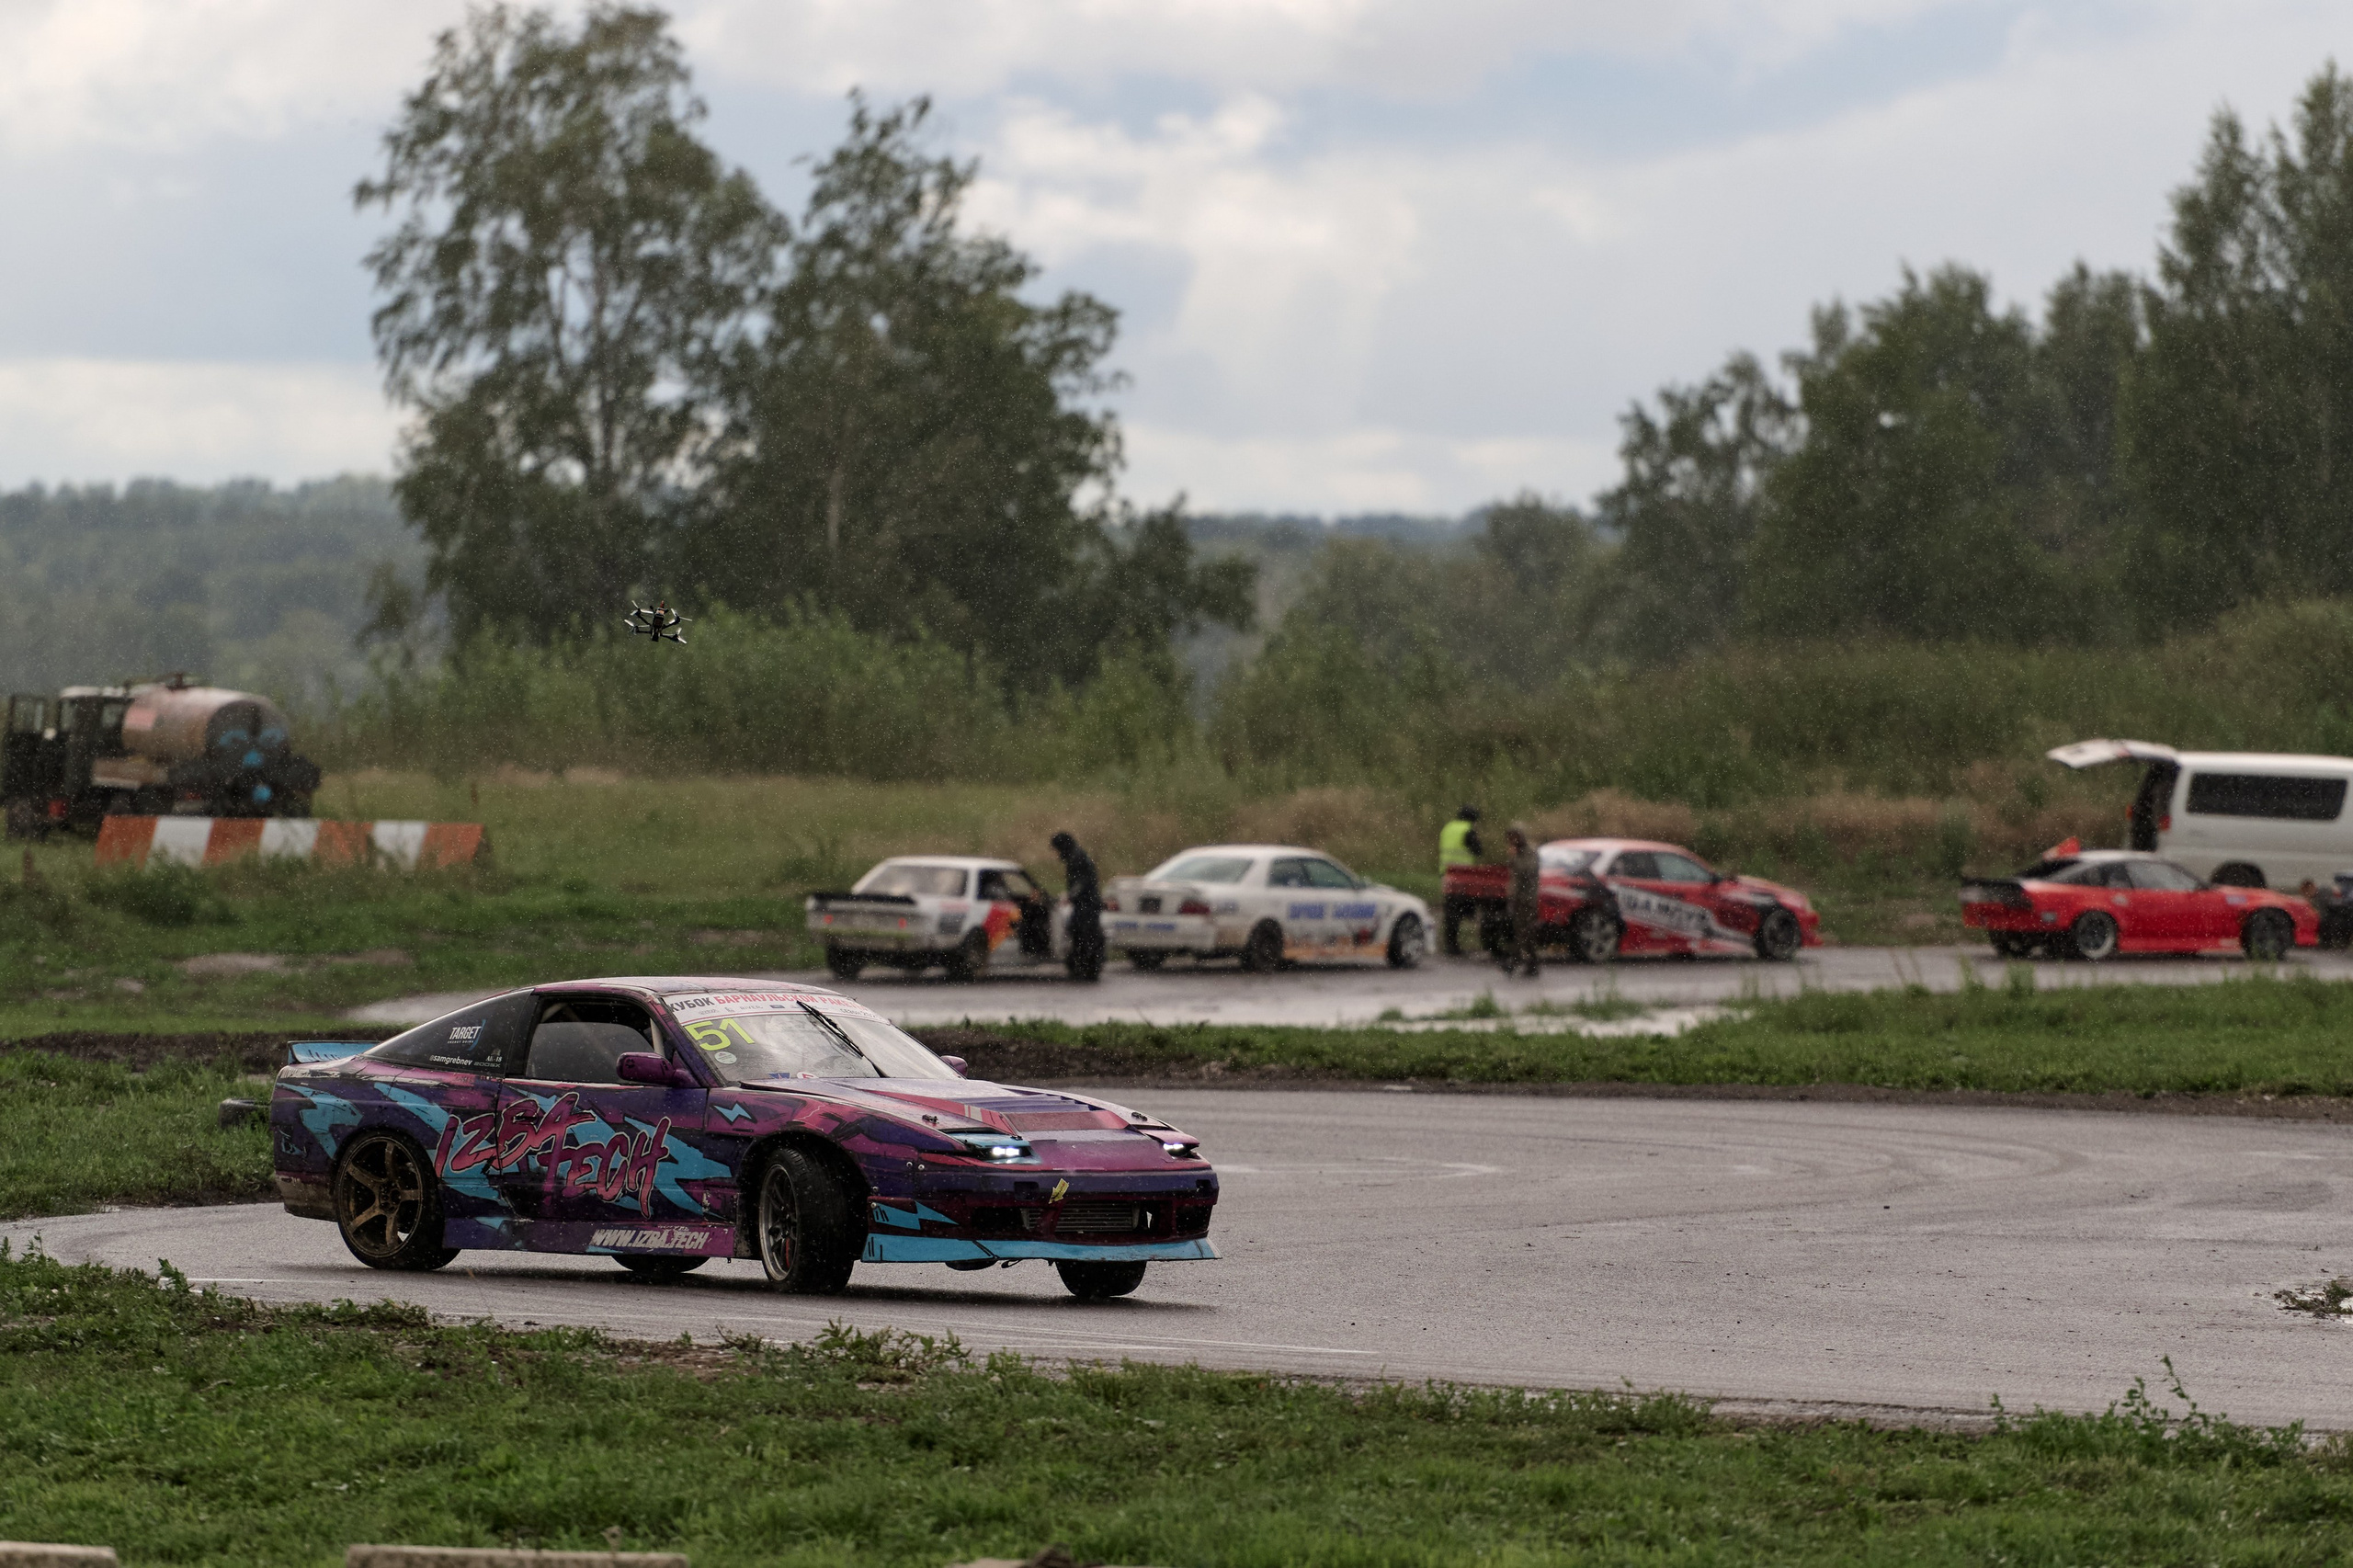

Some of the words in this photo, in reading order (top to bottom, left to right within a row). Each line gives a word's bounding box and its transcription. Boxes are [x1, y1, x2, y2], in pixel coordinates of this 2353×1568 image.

[668, 997, 714, 1012] КУБОК
[714, 994, 818, 1006] БАРНАУЛЬСКОЙ
[449, 1026, 482, 1040] TARGET
[684, 1017, 755, 1051] 51
[435, 1092, 596, 1178] IZBA
[537, 1117, 670, 1219] TECH
[589, 1229, 710, 1249] WWW.IZBA.TECH
